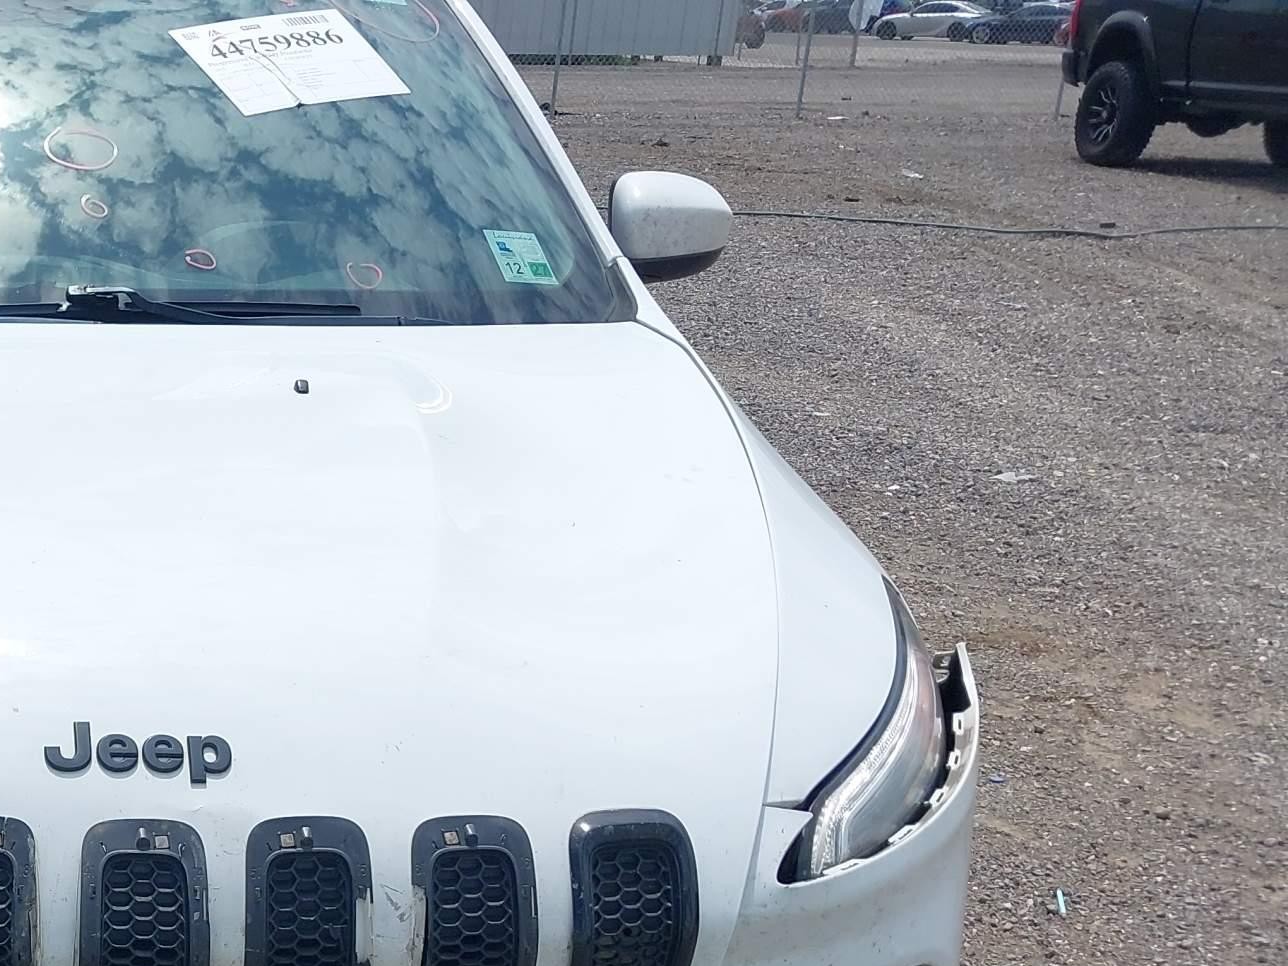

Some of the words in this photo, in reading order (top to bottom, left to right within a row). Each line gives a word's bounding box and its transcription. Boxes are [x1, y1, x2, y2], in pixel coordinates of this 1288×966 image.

[211, 28, 344, 59] 44759886
[505, 262, 525, 275] 12
[44, 721, 232, 785] Jeep
